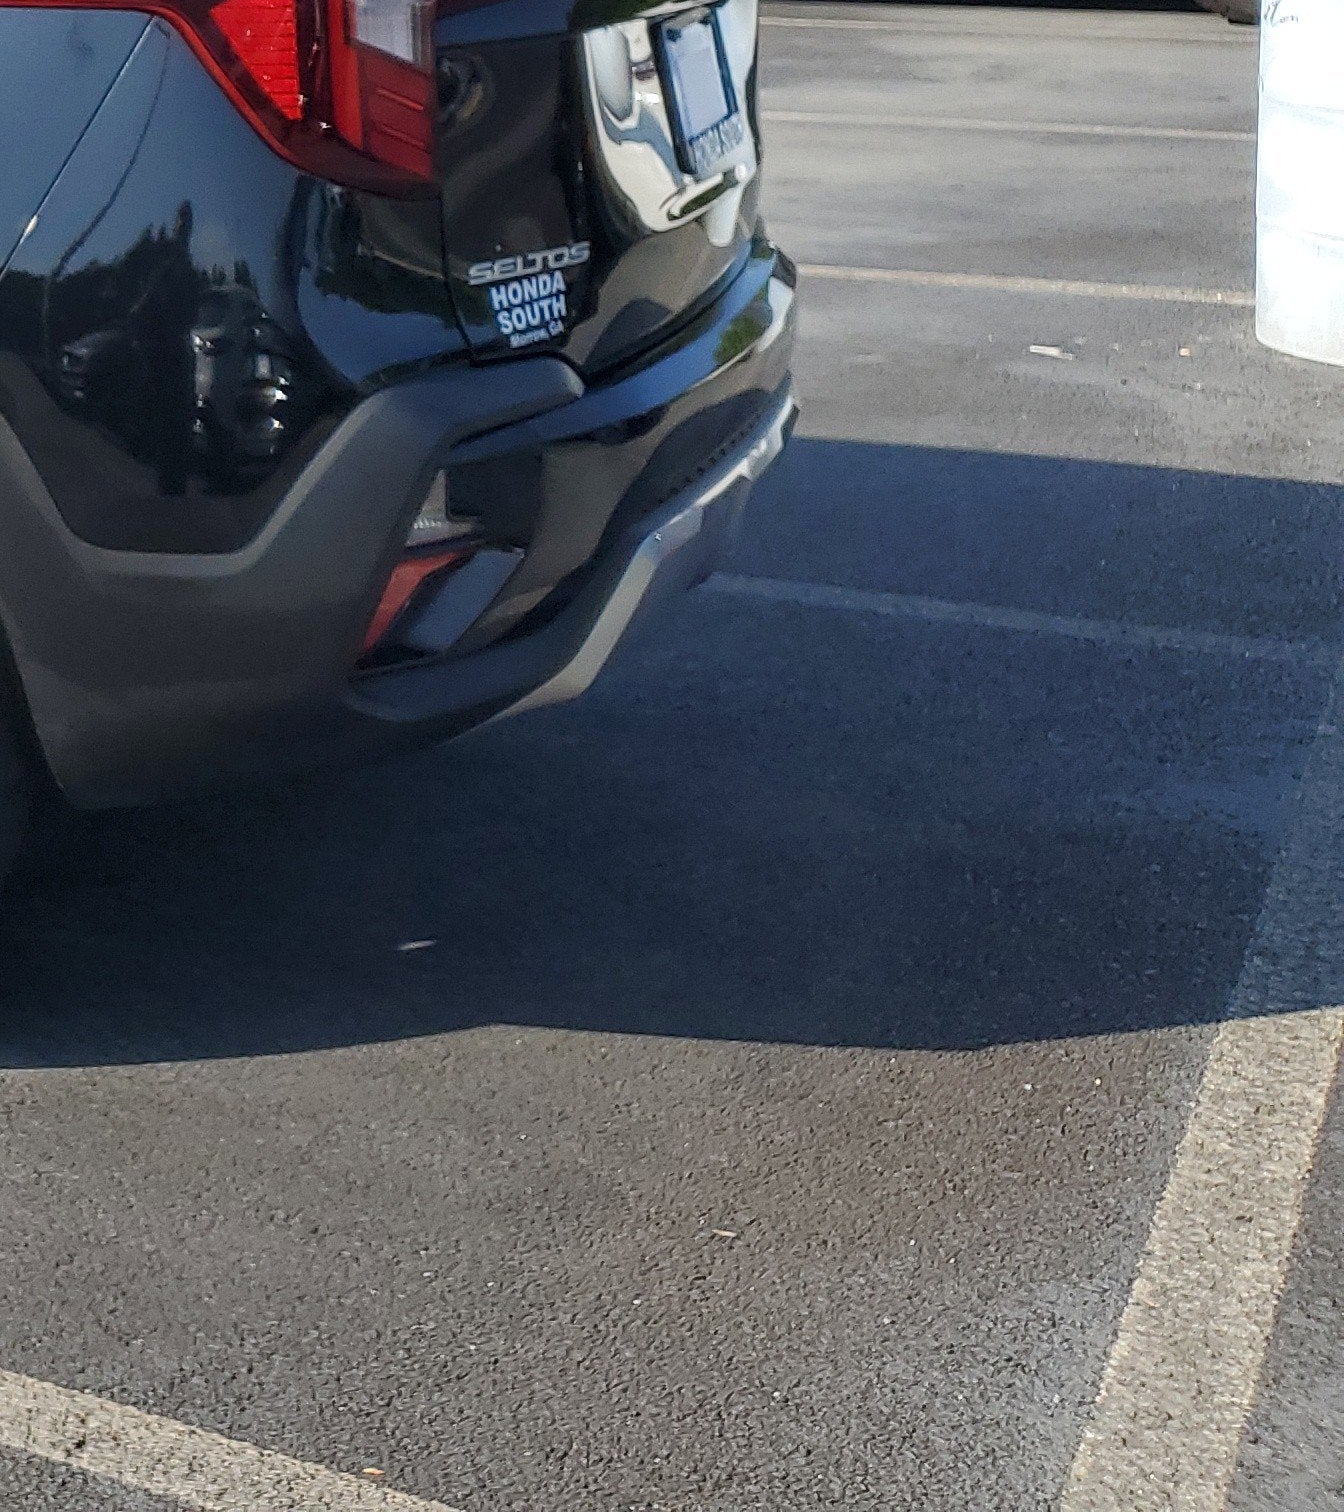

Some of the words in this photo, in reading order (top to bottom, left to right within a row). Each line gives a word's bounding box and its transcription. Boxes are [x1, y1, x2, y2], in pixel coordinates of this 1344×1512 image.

[468, 240, 591, 285] SELTOS
[490, 270, 566, 310] HONDA
[496, 293, 567, 335] SOUTH
